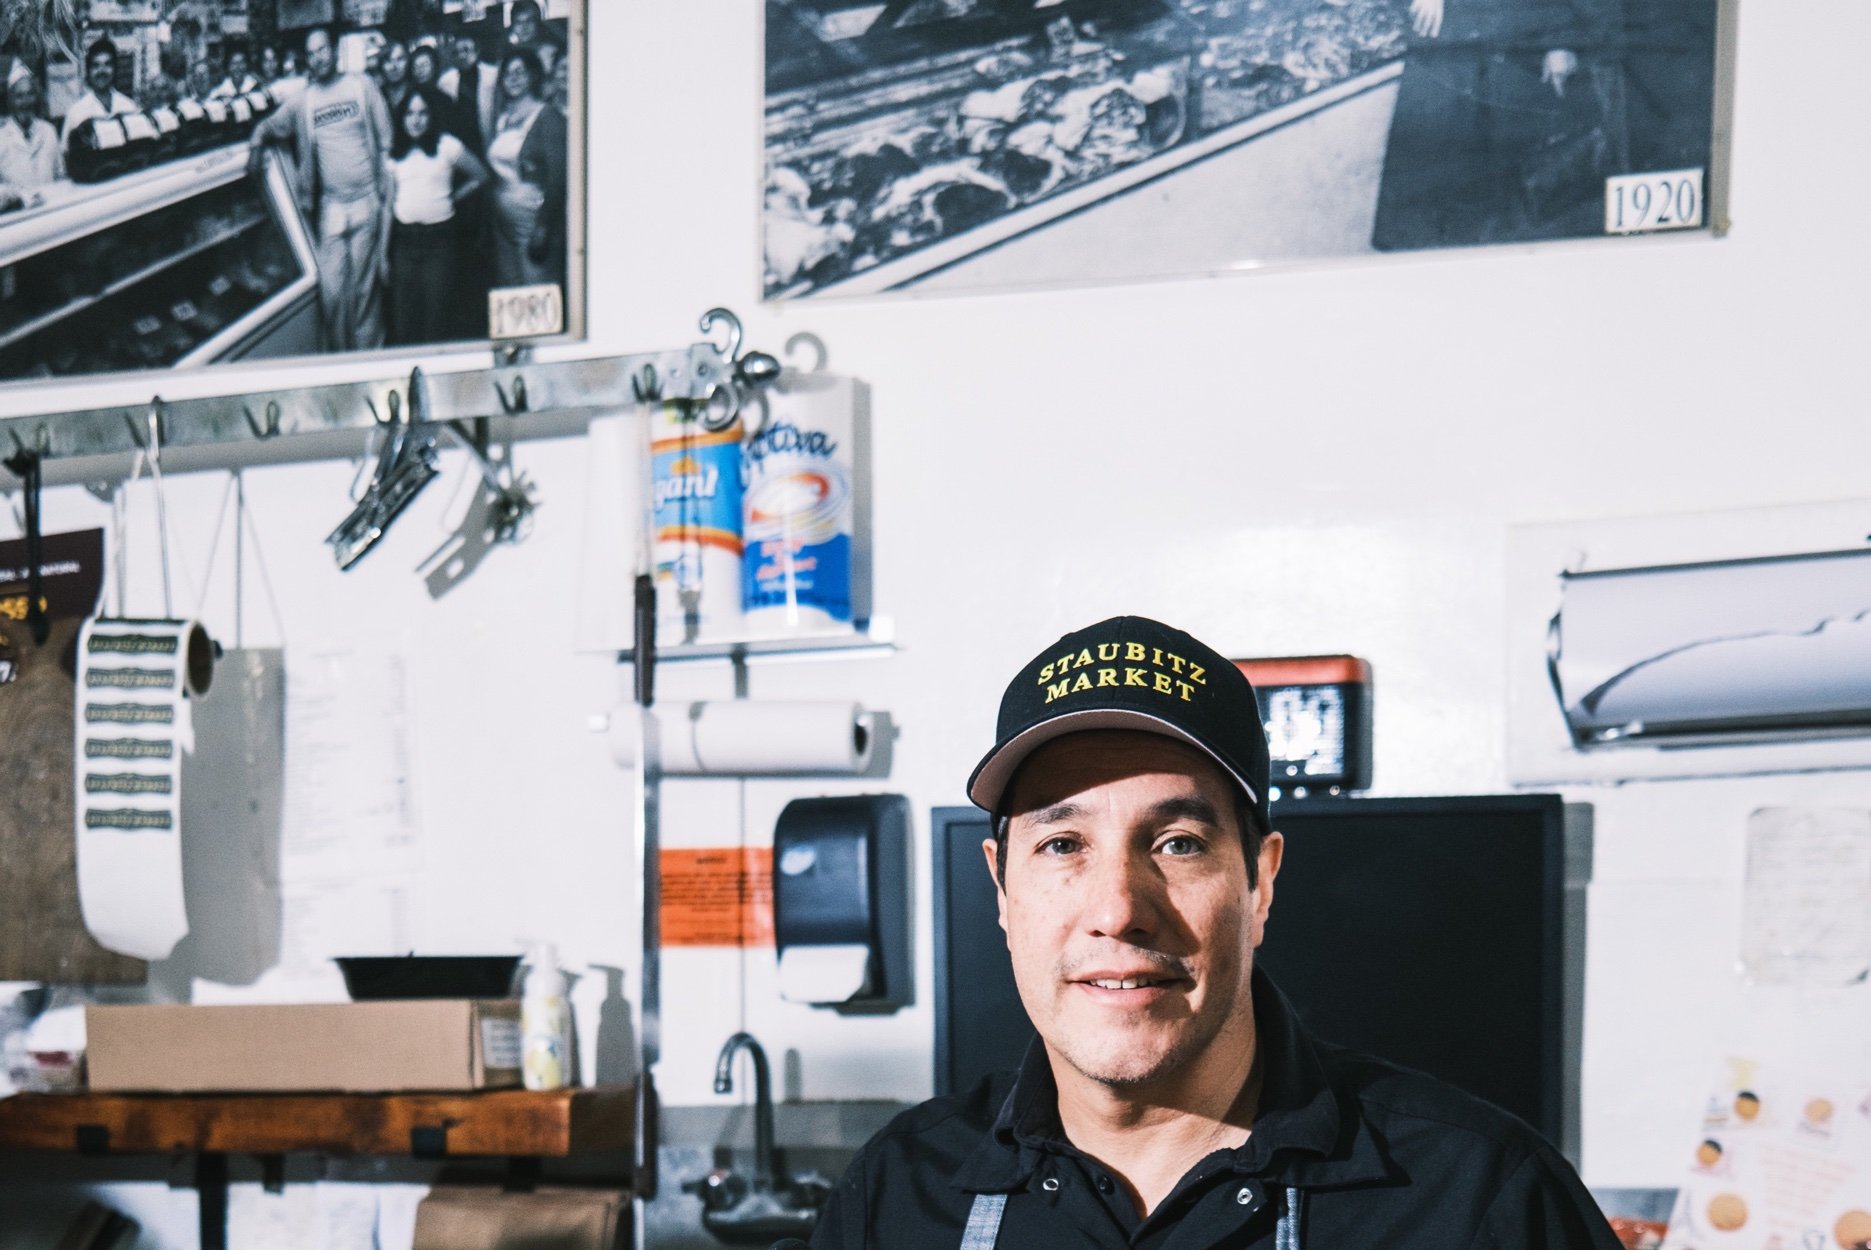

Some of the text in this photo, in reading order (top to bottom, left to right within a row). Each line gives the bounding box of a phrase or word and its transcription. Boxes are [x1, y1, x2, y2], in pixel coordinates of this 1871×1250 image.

[1615, 179, 1695, 228] 1920
[496, 292, 558, 333] 1980
[1038, 641, 1206, 685] STAUBITZ
[1045, 667, 1195, 704] MARKET
